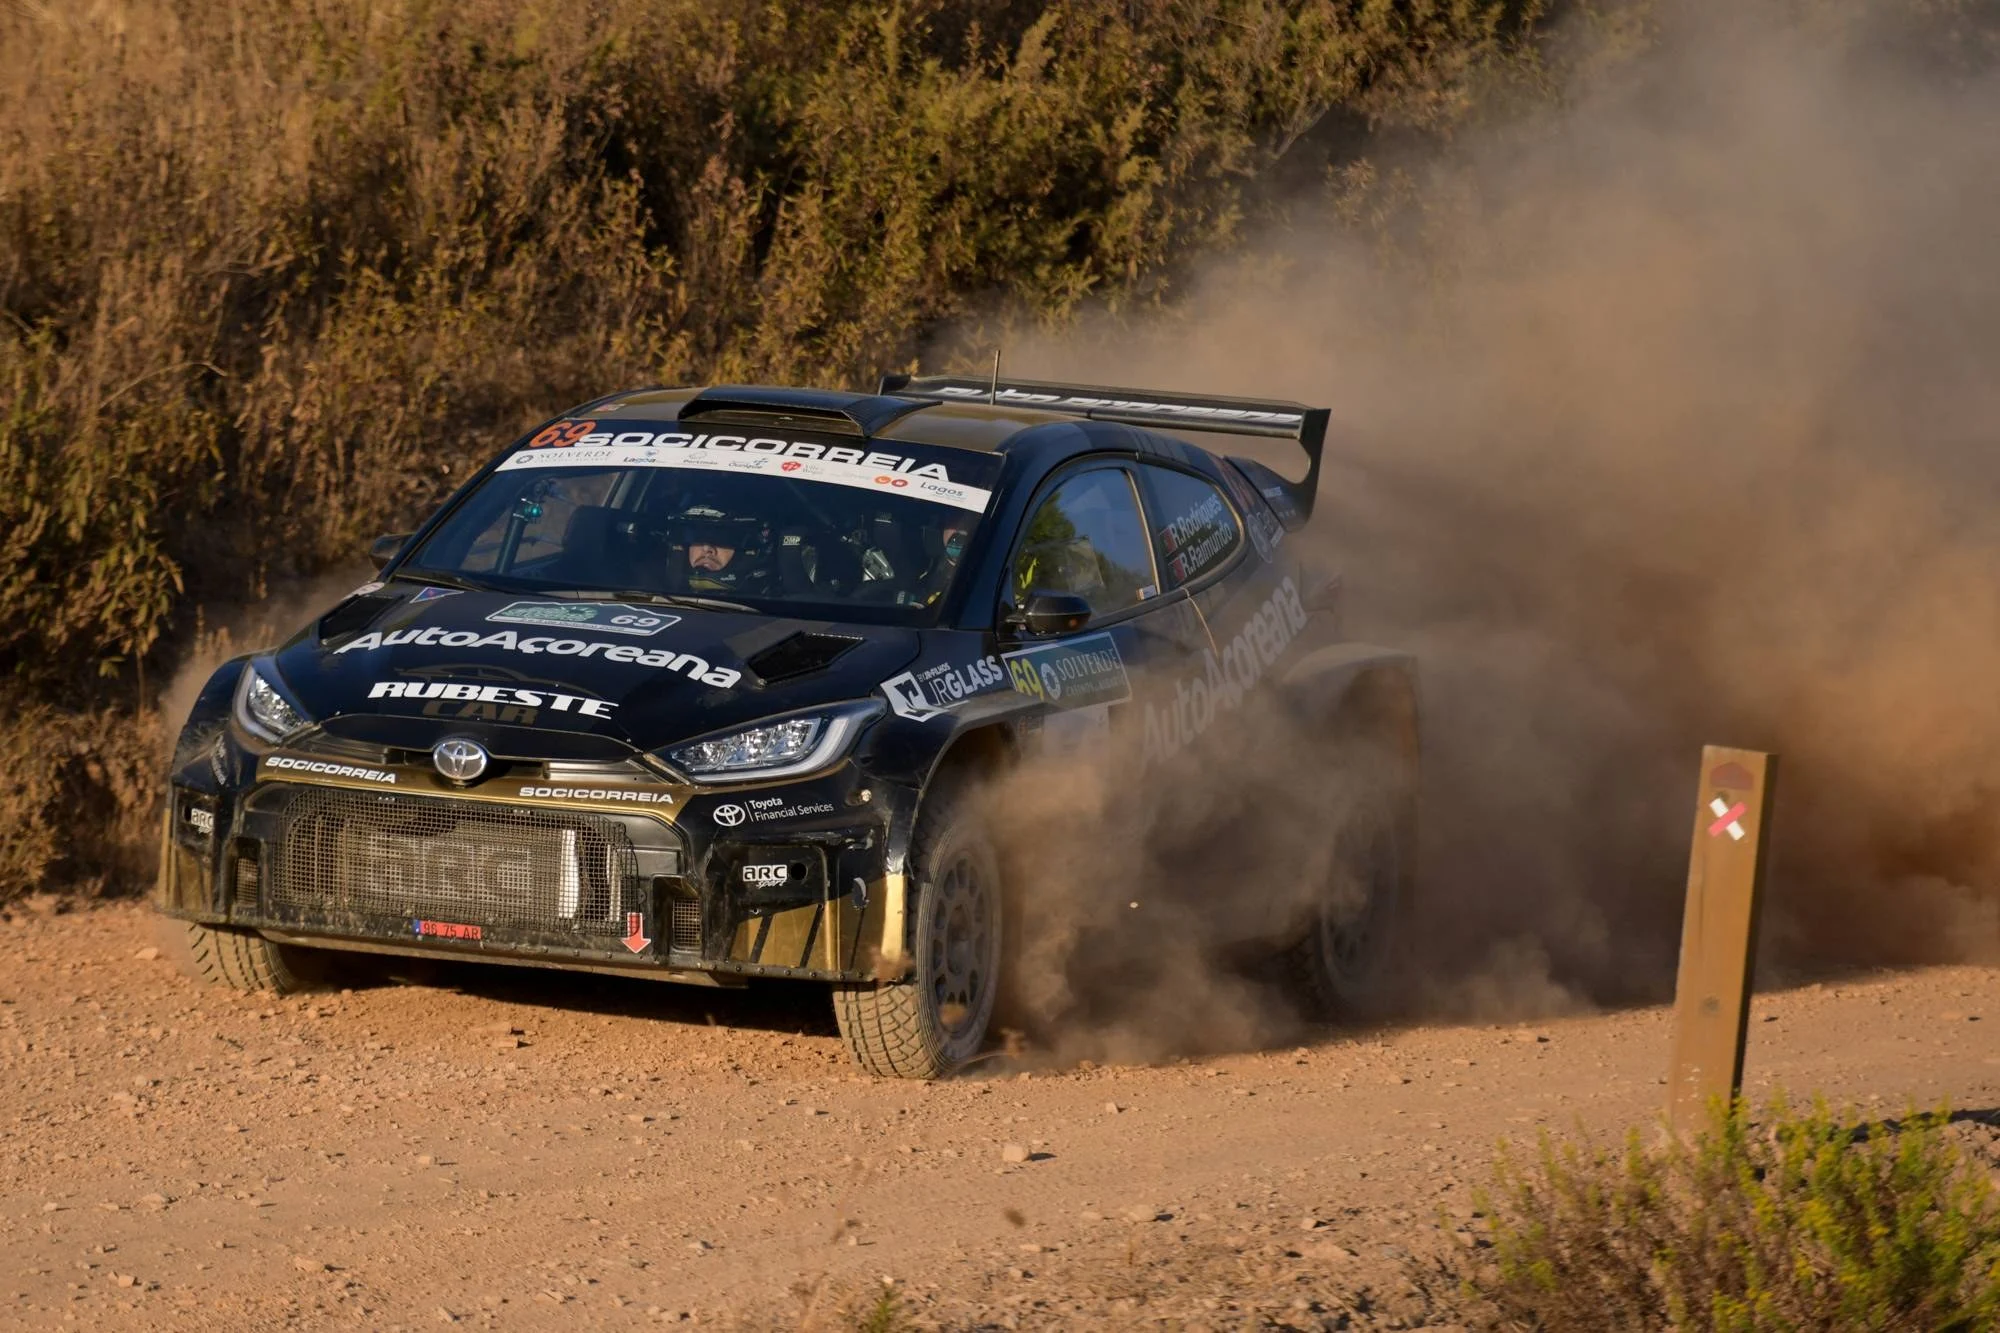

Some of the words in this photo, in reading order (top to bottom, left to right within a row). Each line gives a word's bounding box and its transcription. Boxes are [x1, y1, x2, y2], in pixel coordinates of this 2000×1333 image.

[529, 420, 597, 448] 69
[574, 432, 950, 482] SOCICORREIA
[920, 481, 964, 497] Lagos
[610, 614, 661, 628] 69
[333, 626, 742, 690] AutoAçoreana
[1056, 647, 1121, 681] SOLVERDE
[368, 681, 620, 720] RUBESTE
[265, 756, 397, 784] SOCICORREIA
[519, 786, 674, 805] SOCICORREIA
[749, 797, 784, 811] Toyota
[754, 805, 798, 822] Financial
[798, 802, 835, 816] Services
